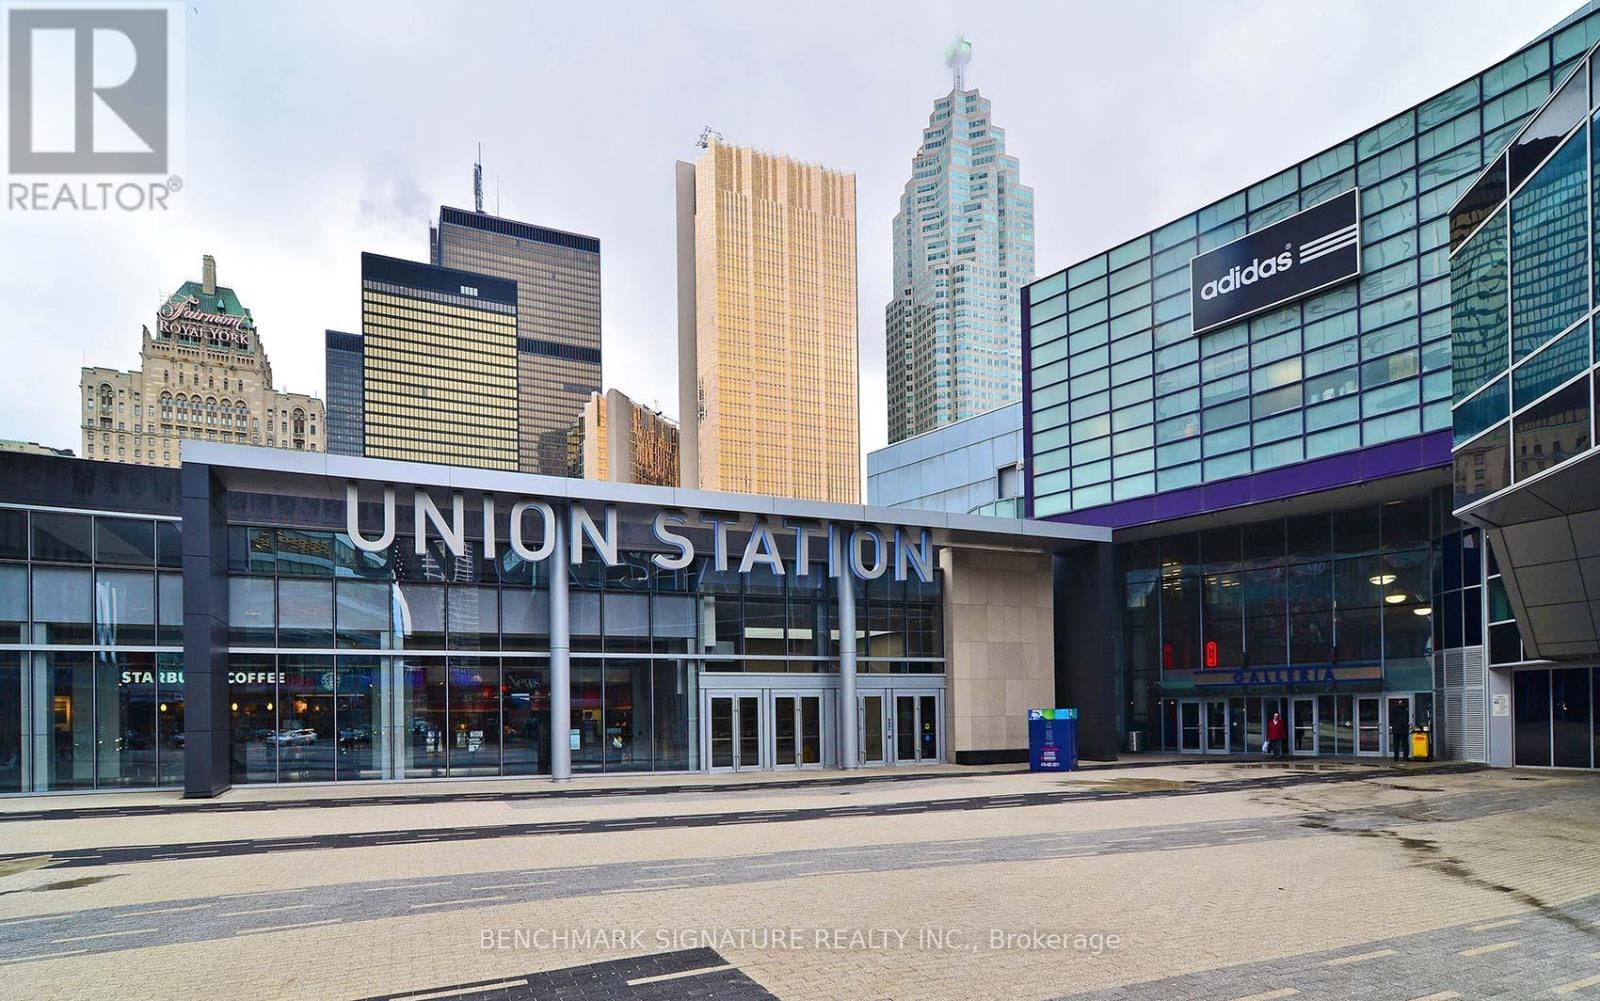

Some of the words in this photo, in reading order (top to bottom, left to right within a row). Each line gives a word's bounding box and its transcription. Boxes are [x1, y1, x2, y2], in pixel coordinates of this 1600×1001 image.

[159, 294, 248, 333] Fairmont
[160, 319, 208, 339] ROYAL
[210, 326, 249, 345] YORK
[347, 485, 618, 567] UNION
[651, 506, 935, 583] STATION
[121, 671, 185, 684] STARBU
[228, 672, 286, 684] COFFEE
[1232, 666, 1337, 686] GALLERIA
